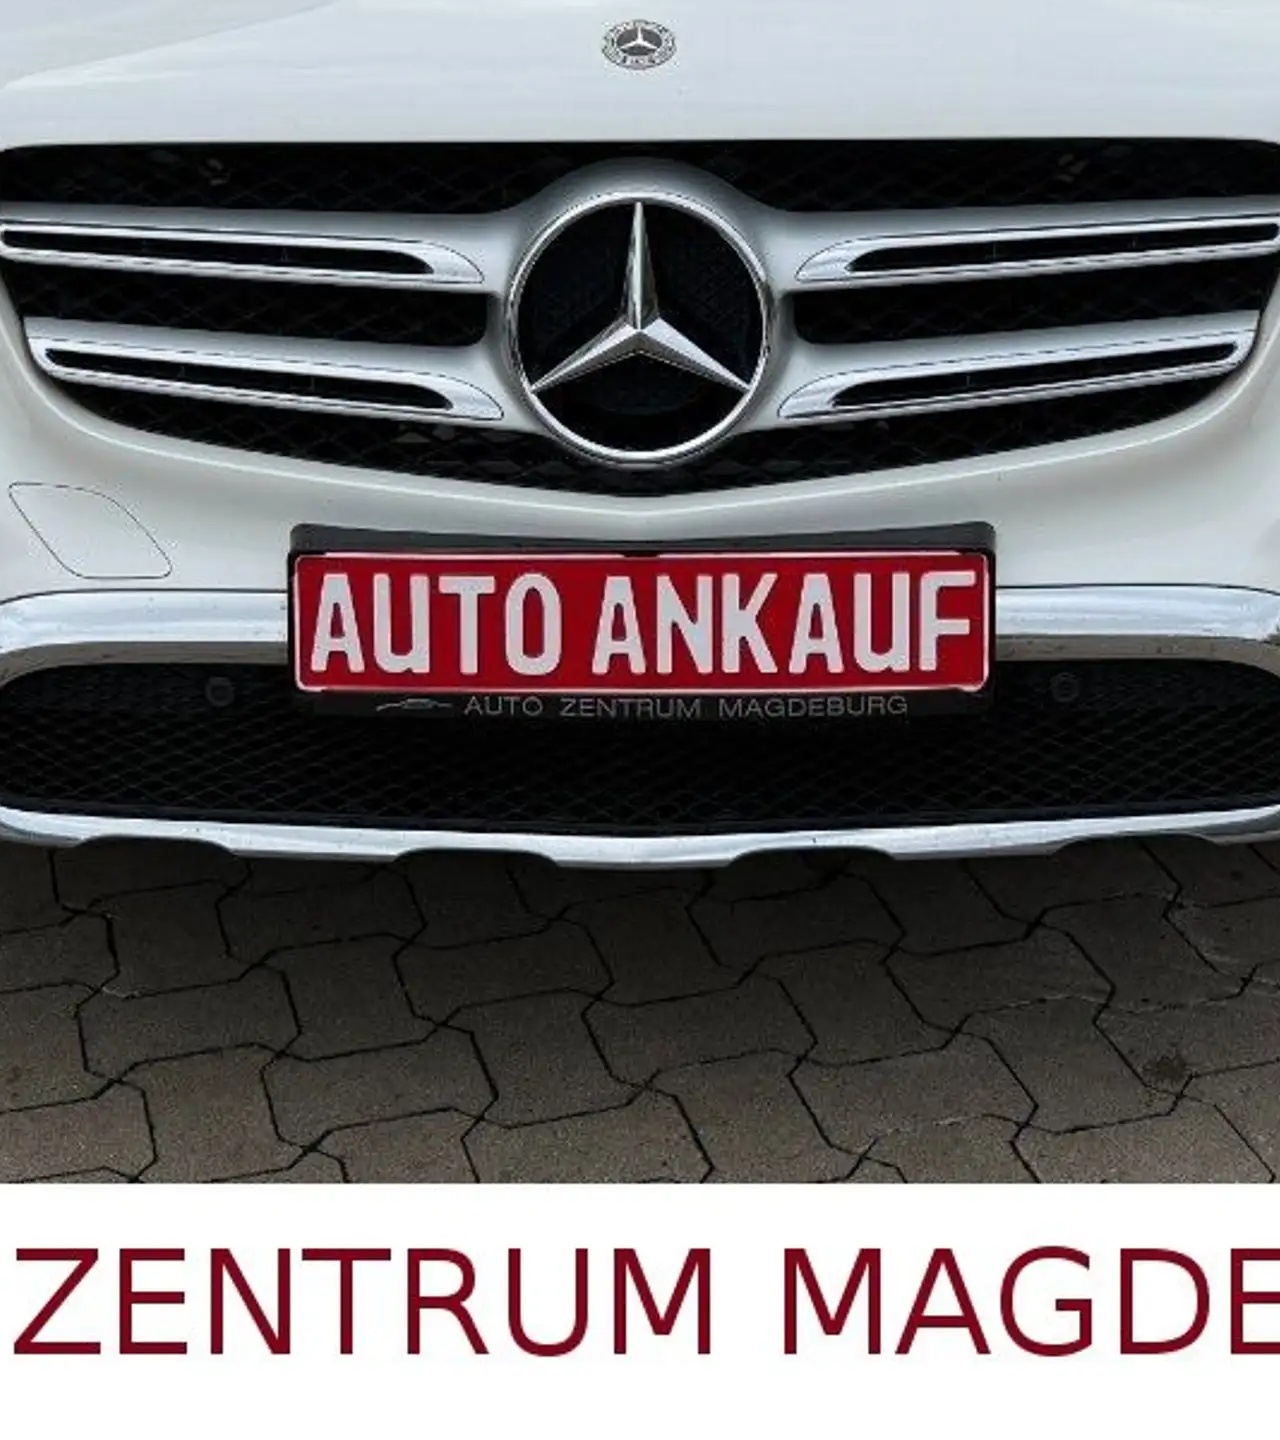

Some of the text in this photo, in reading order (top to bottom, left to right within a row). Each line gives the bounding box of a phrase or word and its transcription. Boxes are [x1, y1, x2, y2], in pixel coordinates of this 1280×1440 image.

[311, 570, 976, 675] AUTO ANKAUF
[464, 695, 909, 718] AUTO ZENTRUM MAGDEBURG
